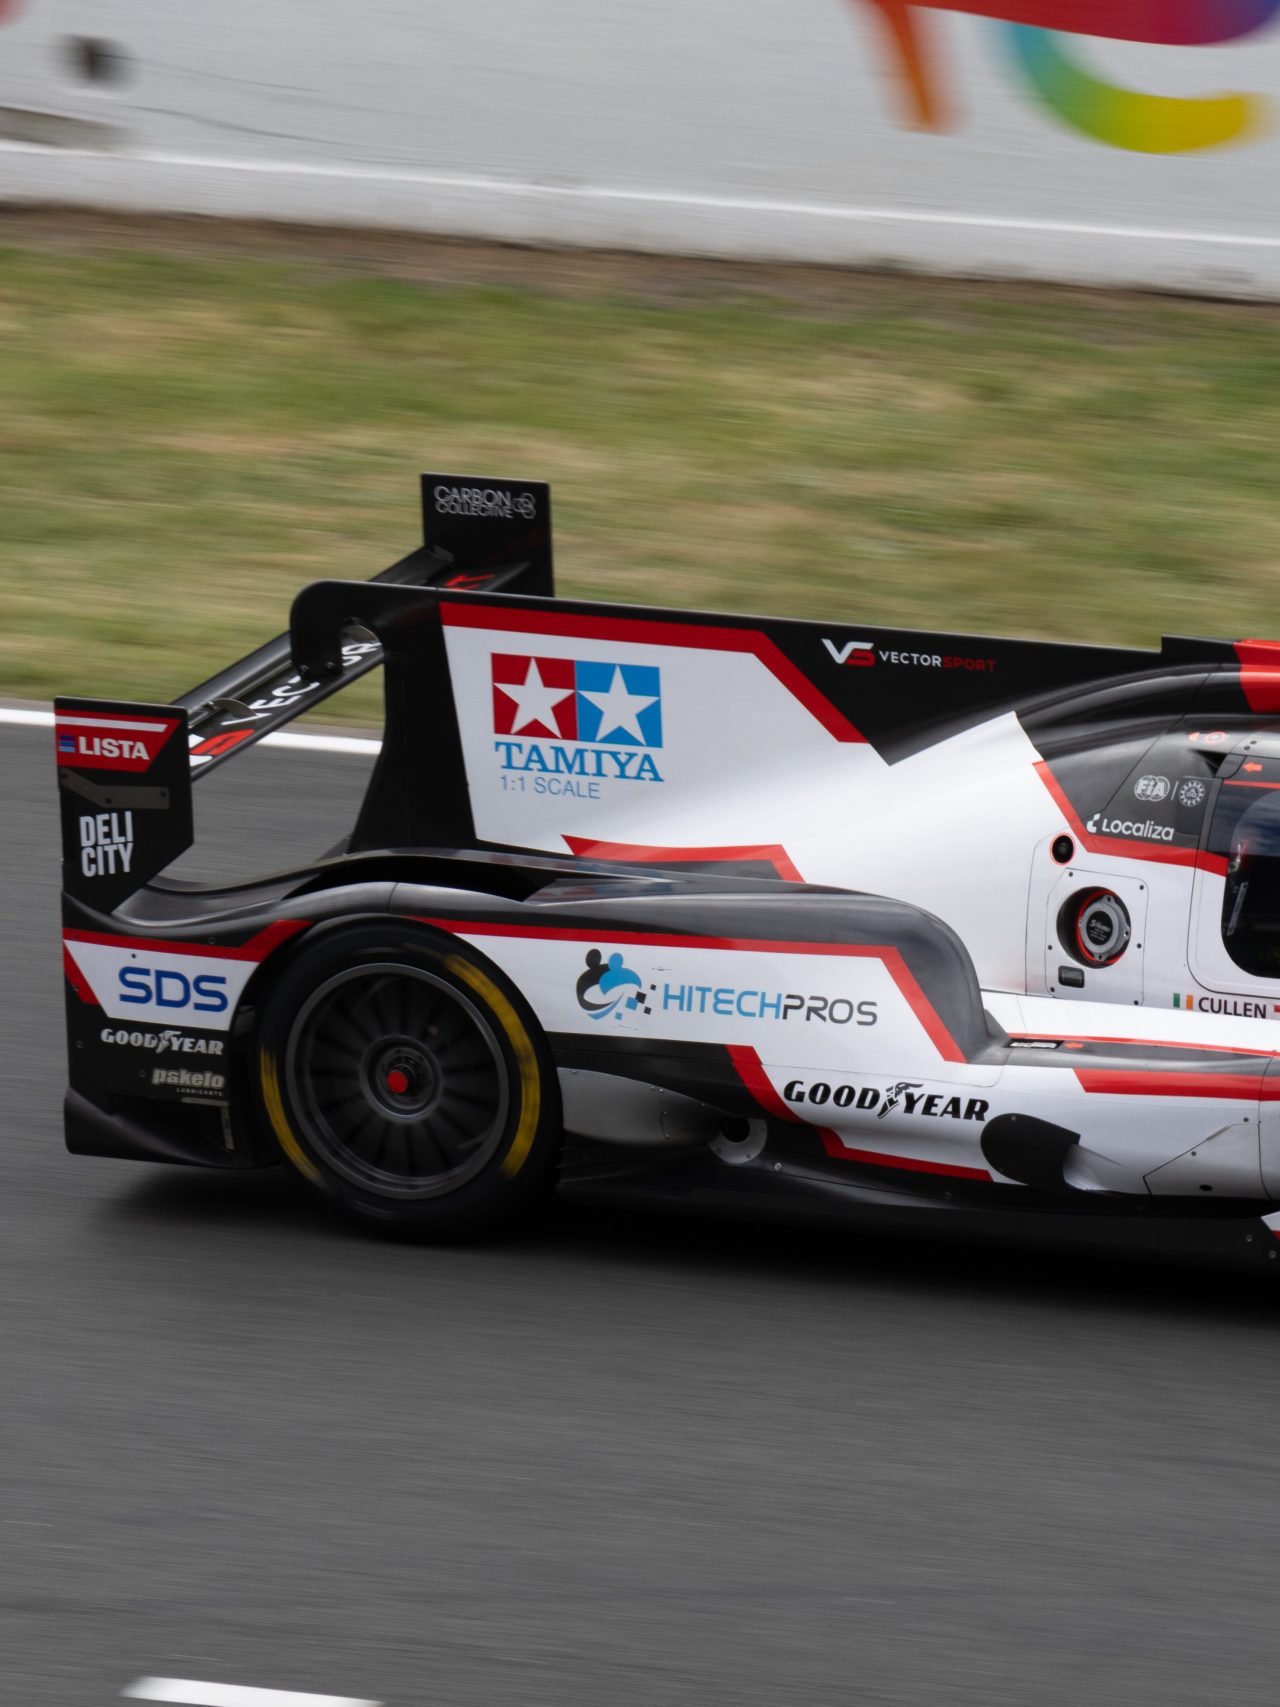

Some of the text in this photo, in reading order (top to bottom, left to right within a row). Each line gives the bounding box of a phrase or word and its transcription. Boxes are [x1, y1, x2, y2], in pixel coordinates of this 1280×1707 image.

[433, 485, 512, 506] CARBON
[435, 500, 514, 519] COLLECTIVE
[78, 736, 150, 761] LISTA
[495, 741, 664, 783] TAMIYA
[500, 775, 600, 799] 1:1 SCALE
[1135, 777, 1170, 799] FIA
[79, 811, 134, 848] DELI
[1102, 818, 1175, 841] Localiza
[81, 842, 134, 878] CITY
[118, 966, 229, 1013] SDS
[663, 983, 878, 1026] HITECHPROS
[1198, 996, 1267, 1019] CULLEN
[152, 1067, 225, 1089] pakelo
